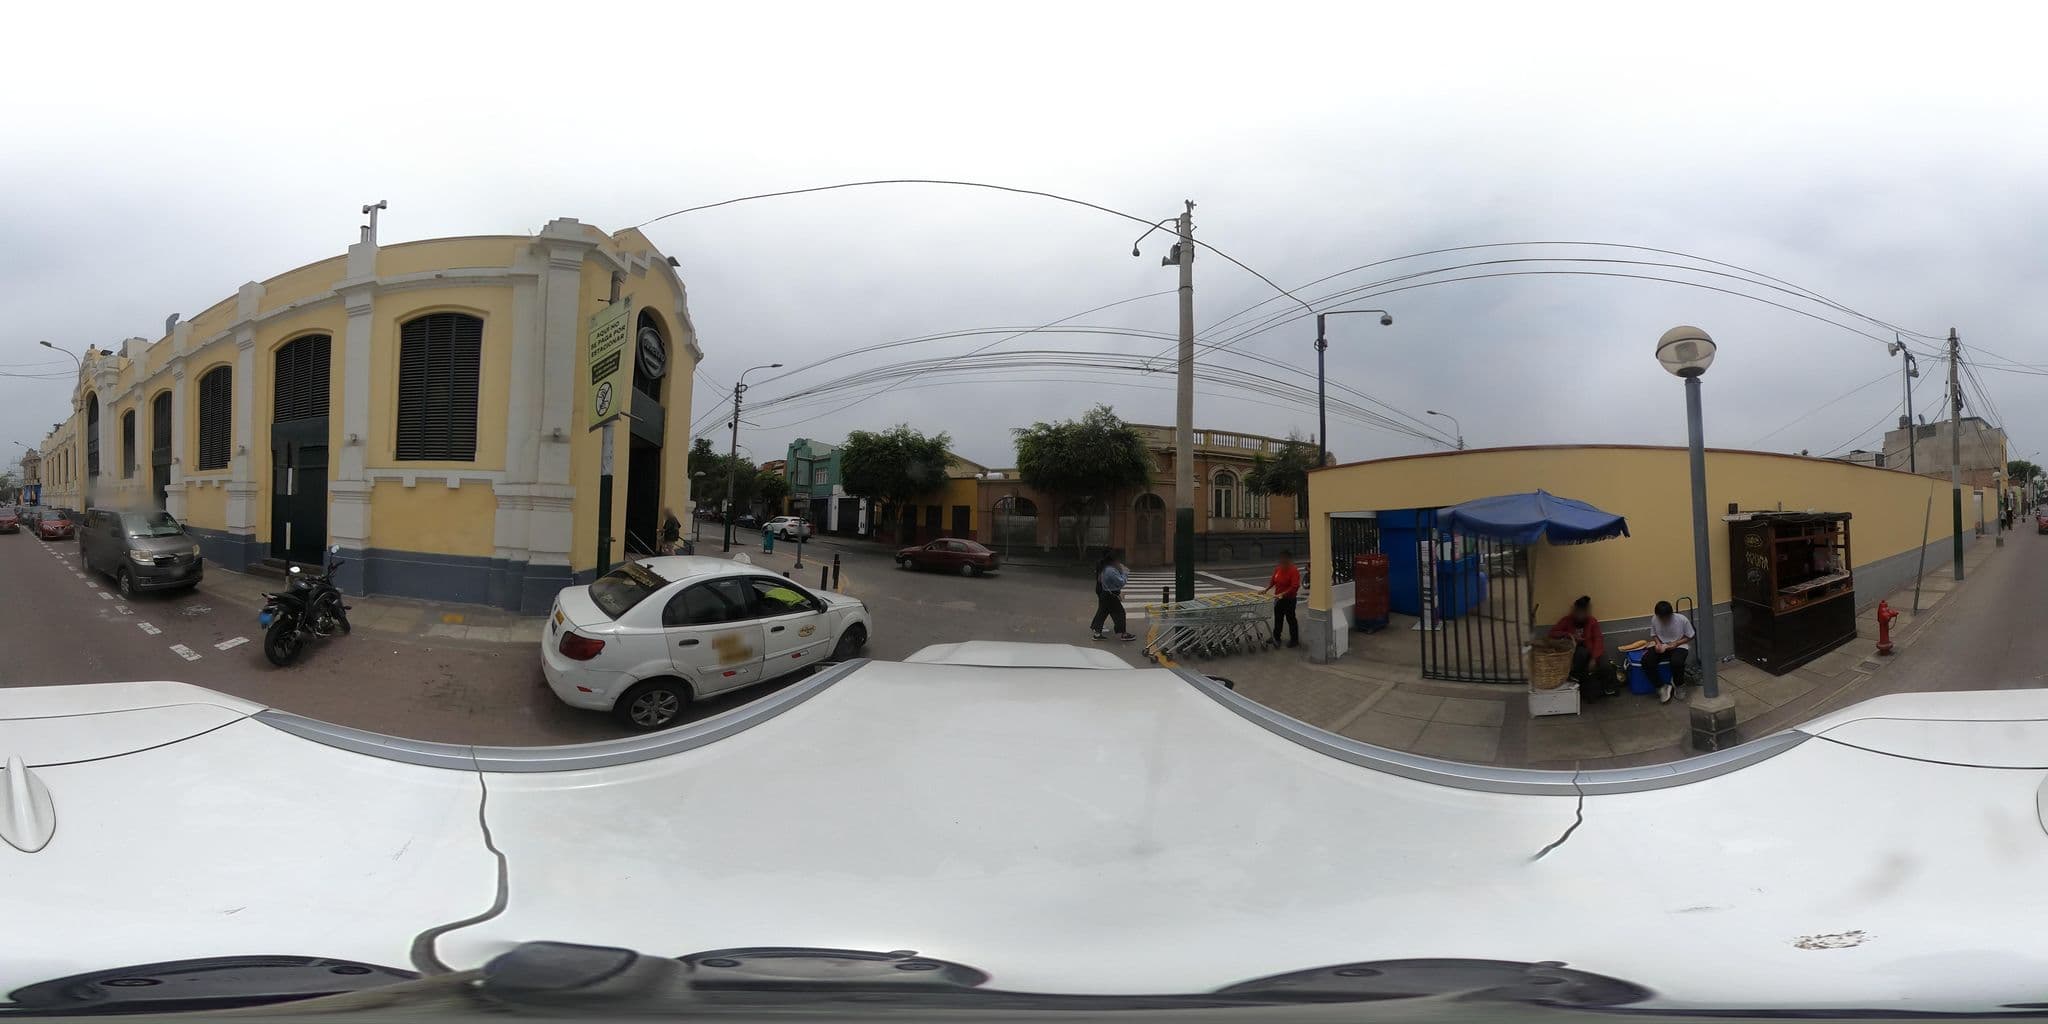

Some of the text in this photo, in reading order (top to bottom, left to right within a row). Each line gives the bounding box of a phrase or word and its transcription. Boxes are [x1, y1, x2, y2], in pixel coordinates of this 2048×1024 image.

[597, 333, 612, 346] PAGA
[613, 325, 626, 336] POR
[611, 321, 620, 330] NO
[591, 333, 625, 358] ESTACIONAR
